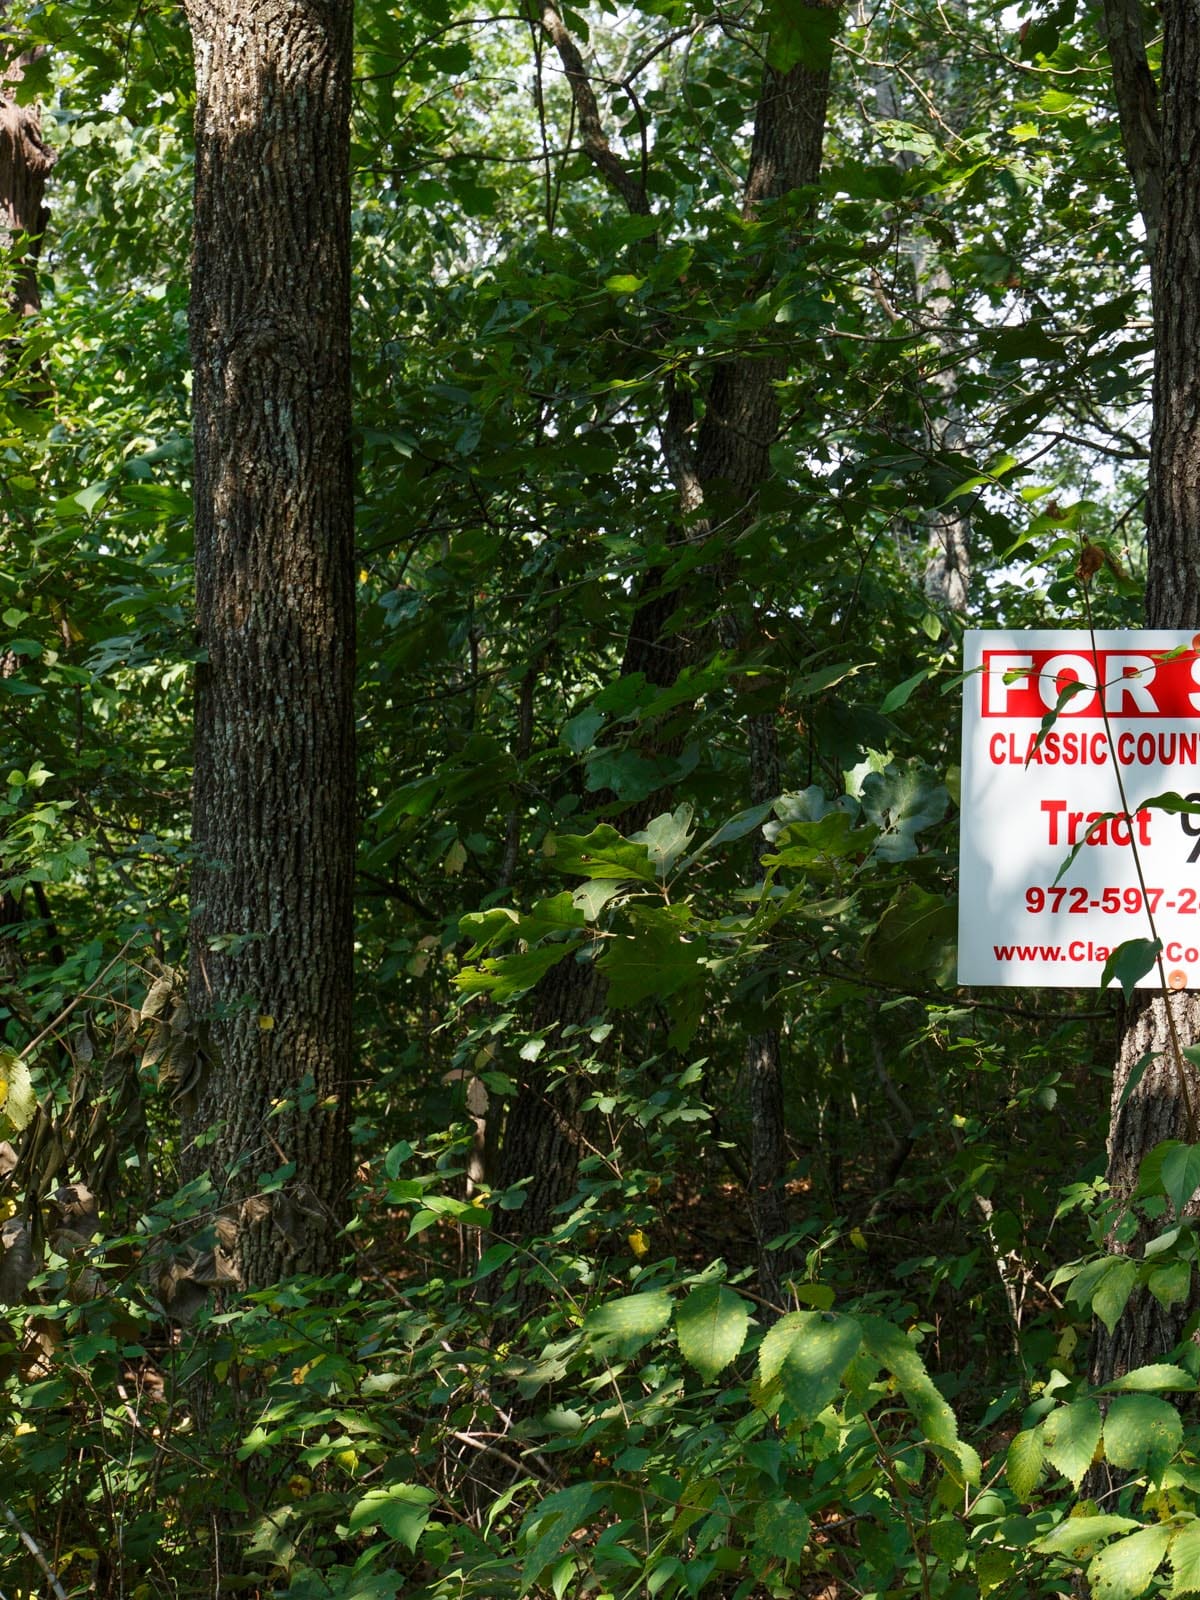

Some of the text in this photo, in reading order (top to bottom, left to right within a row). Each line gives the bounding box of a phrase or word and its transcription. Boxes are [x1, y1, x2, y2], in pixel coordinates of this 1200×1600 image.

[988, 653, 1160, 714] FOR
[989, 732, 1108, 766] CLASSIC
[1040, 799, 1152, 847] Tract
